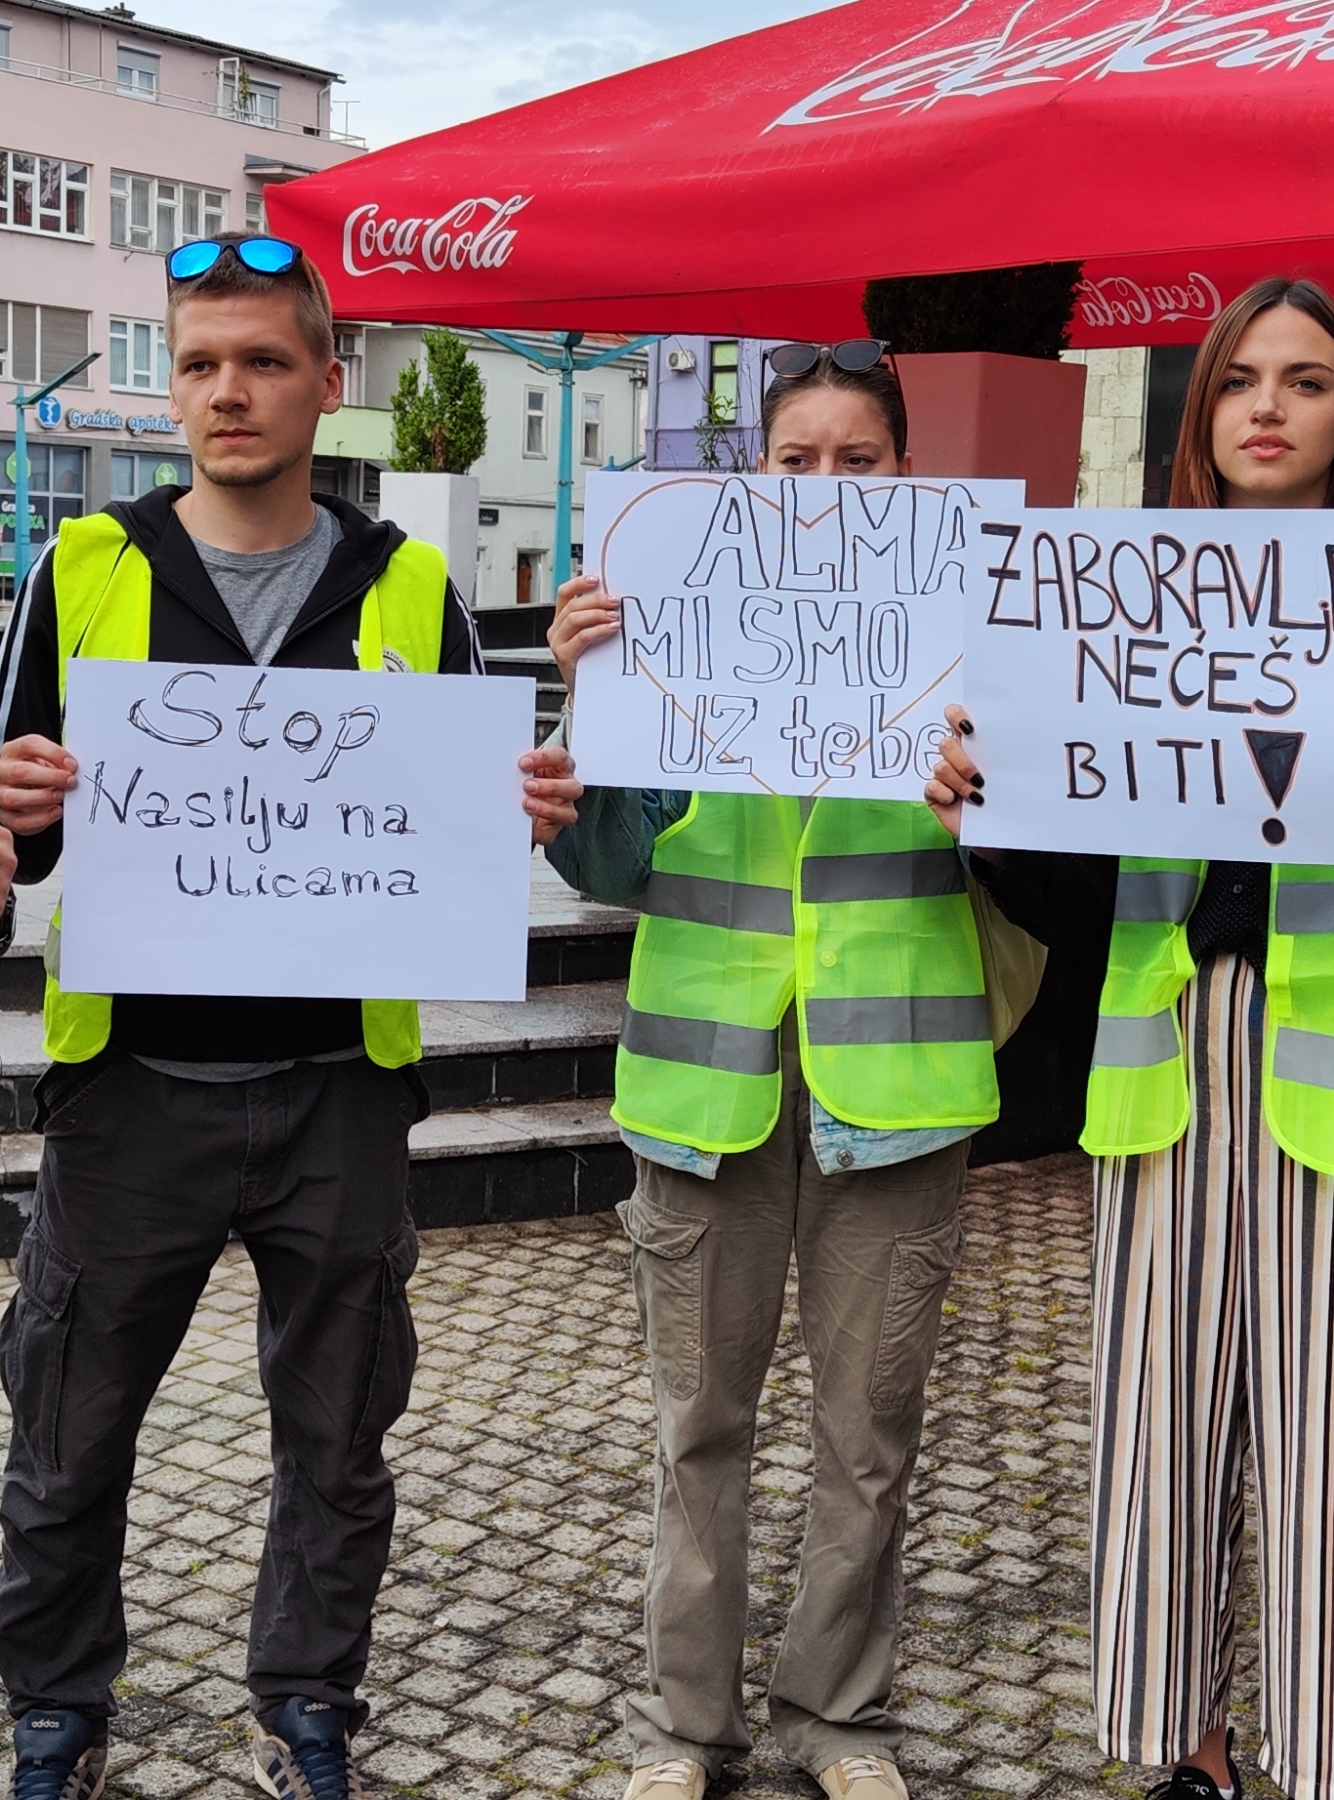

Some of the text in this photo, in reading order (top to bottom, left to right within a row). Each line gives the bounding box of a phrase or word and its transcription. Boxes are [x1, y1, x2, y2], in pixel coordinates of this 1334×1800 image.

[342, 194, 536, 278] Coca-Cola
[69, 409, 124, 428] Gradska
[683, 476, 974, 596] ALMA
[619, 594, 910, 690] MI SMO
[1075, 627, 1299, 717] NEĆEŠ
[126, 670, 382, 784] Stop
[659, 692, 953, 780] UZ tebe
[82, 760, 420, 854] Nasilju na
[30, 1717, 61, 1730] adidas
[304, 1701, 332, 1714] adidas
